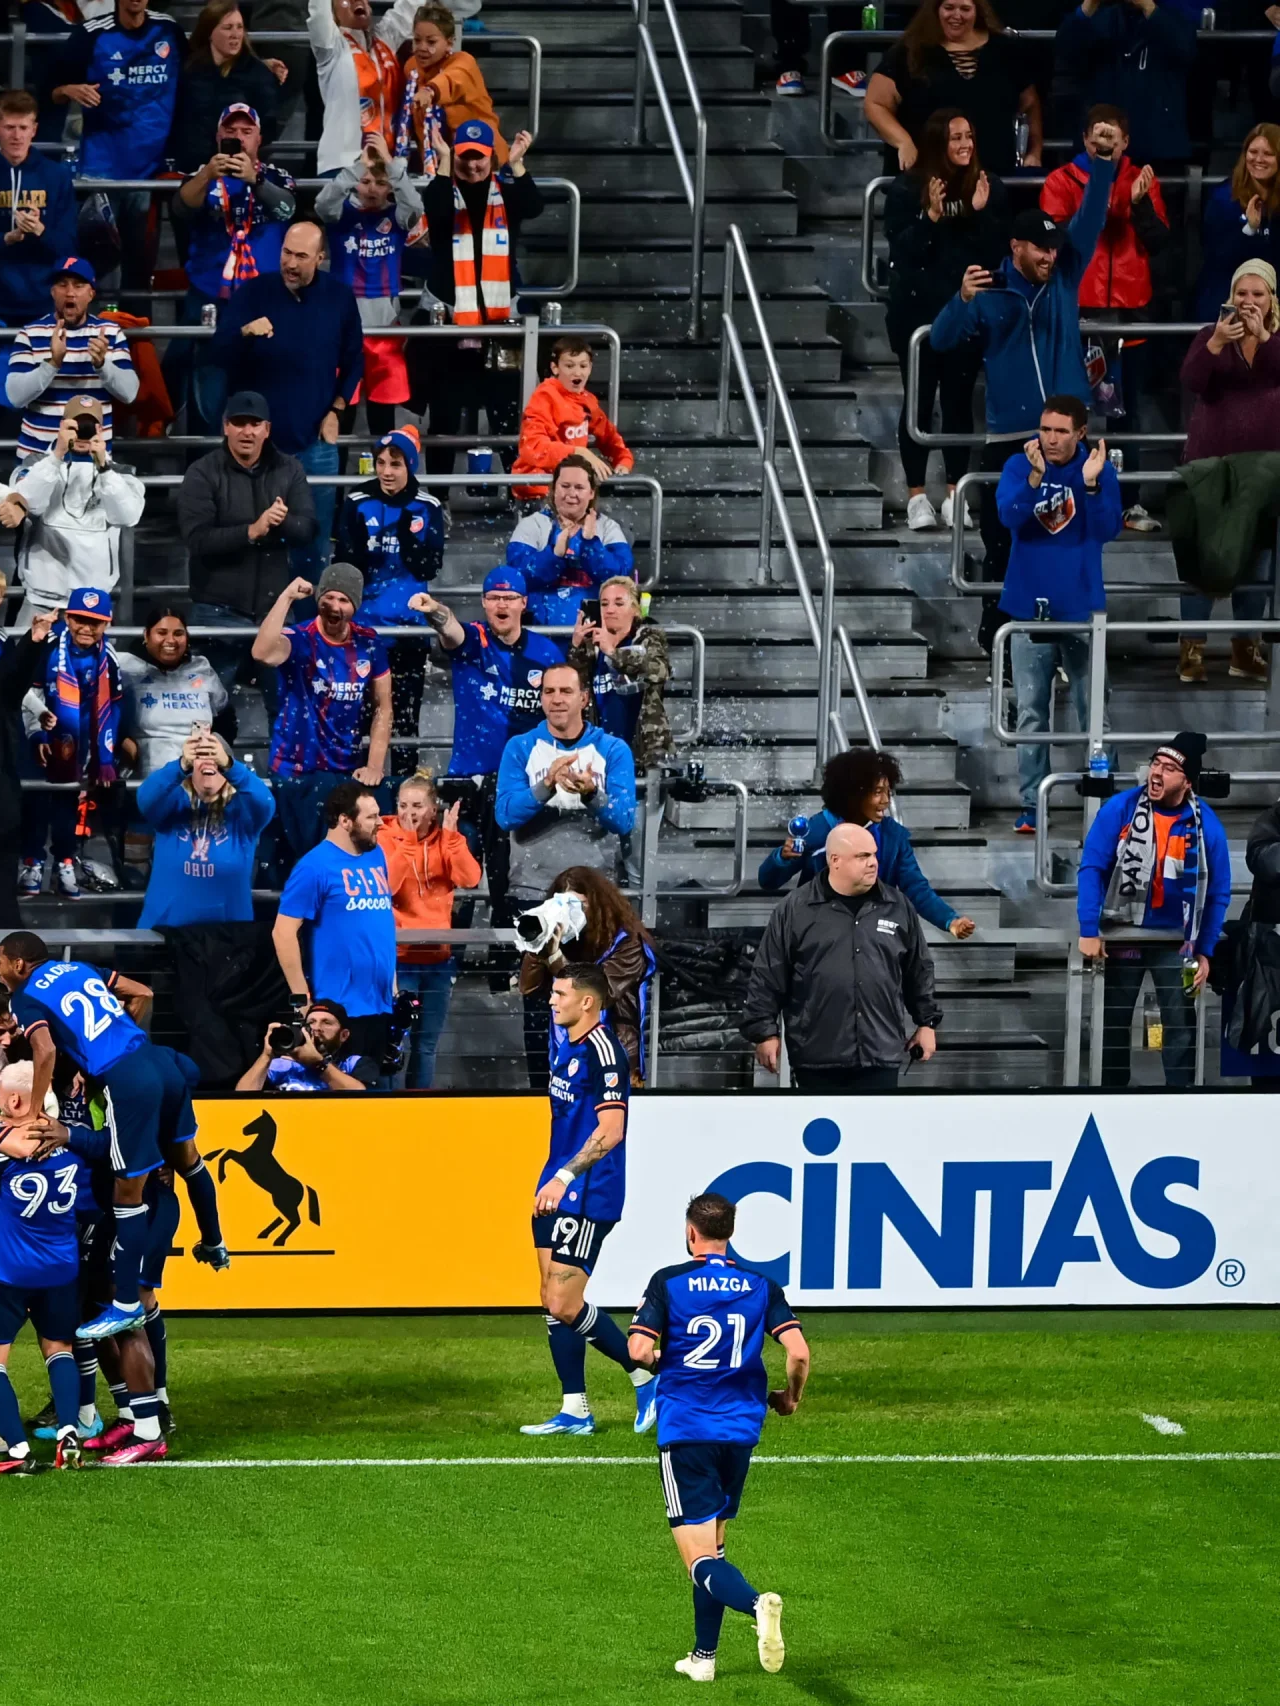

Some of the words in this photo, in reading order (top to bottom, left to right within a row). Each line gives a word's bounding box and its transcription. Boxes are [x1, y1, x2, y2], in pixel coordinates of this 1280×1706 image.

[128, 64, 167, 75] MERCY
[330, 681, 365, 692] MERCY
[500, 686, 541, 699] MERCY
[161, 692, 200, 701] MERCY
[183, 860, 215, 878] OHIO
[60, 977, 125, 1042] 28
[9, 1163, 79, 1218] 93
[551, 1216, 579, 1244] 19
[688, 1276, 752, 1292] MIAZGA
[683, 1313, 746, 1370] 21
